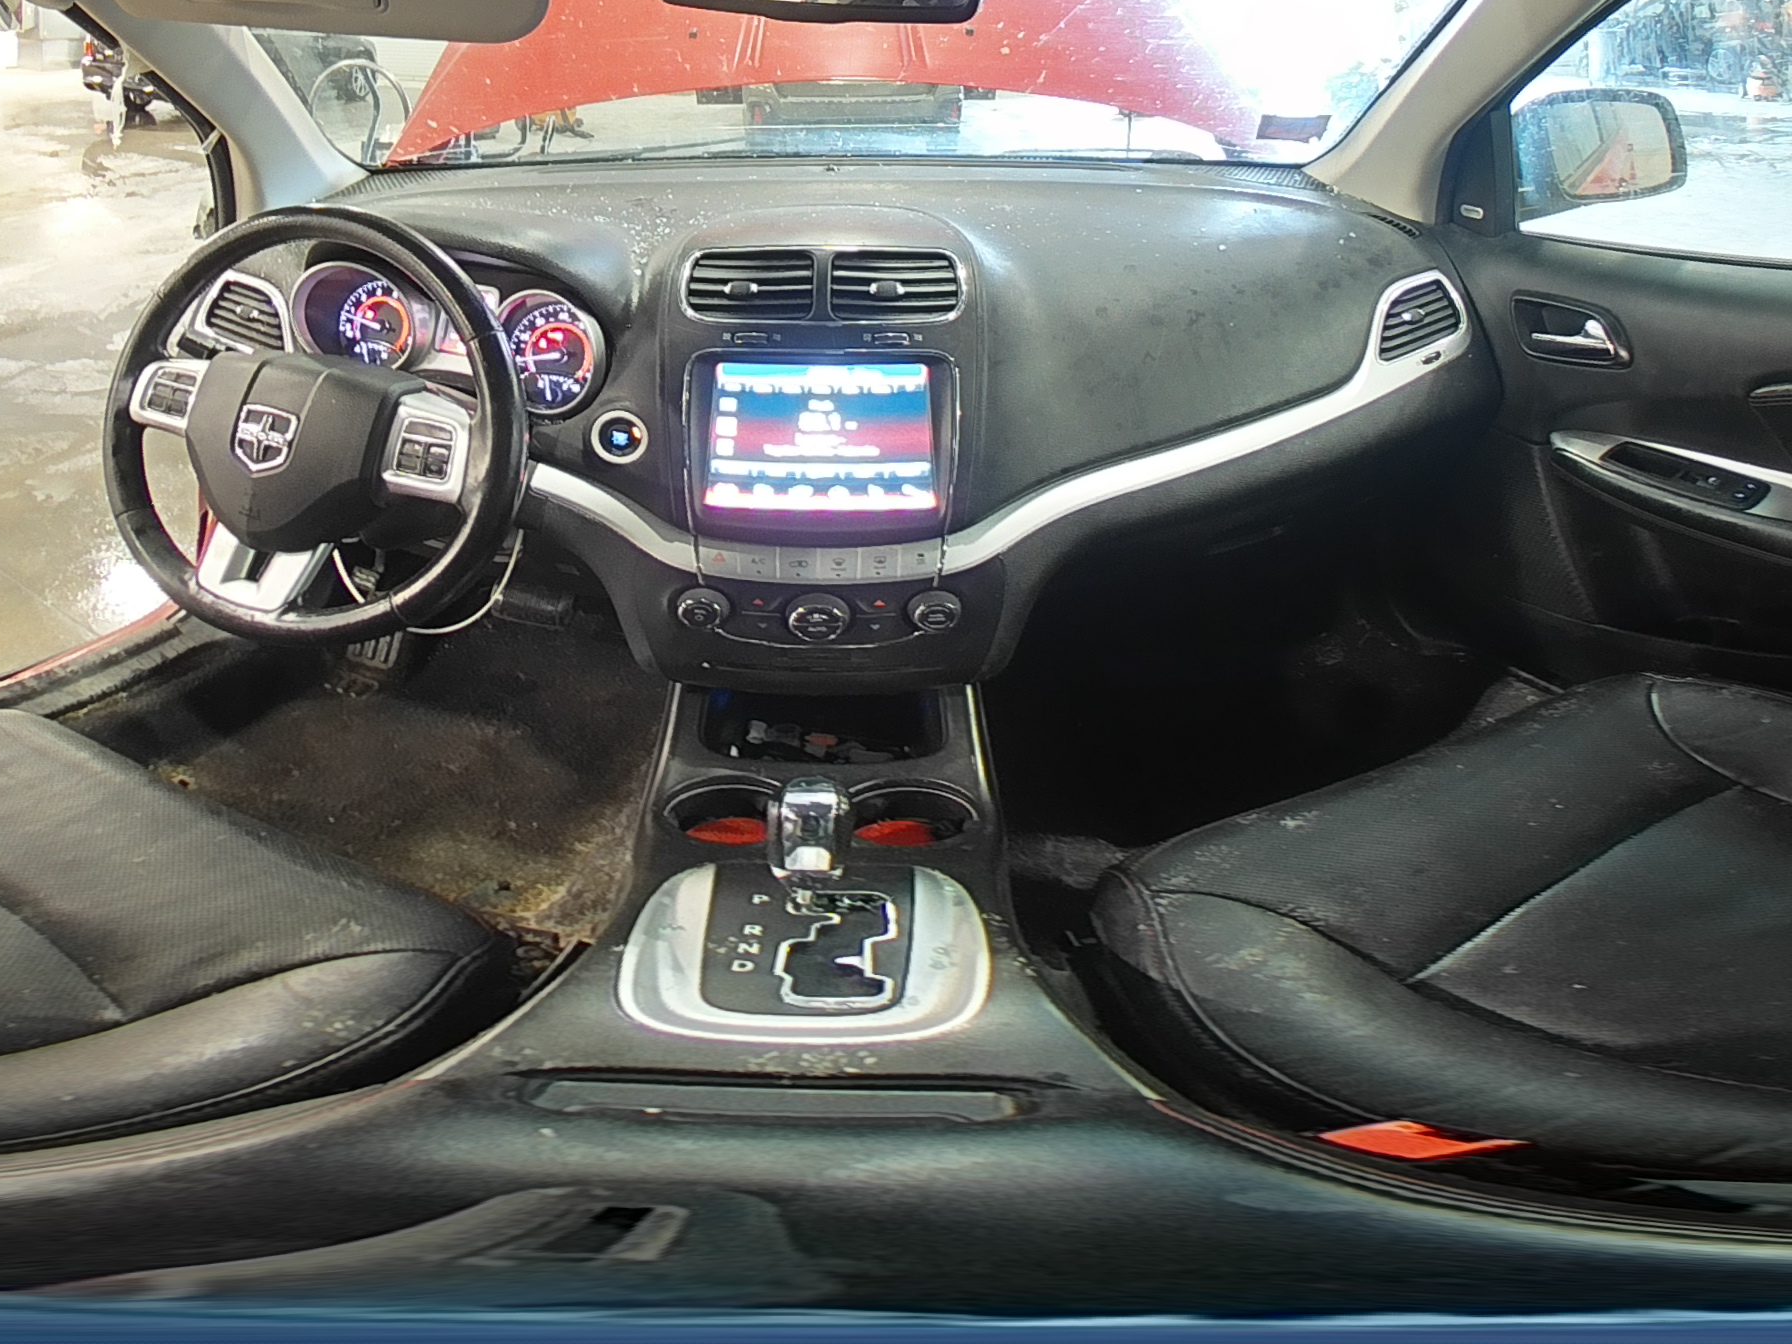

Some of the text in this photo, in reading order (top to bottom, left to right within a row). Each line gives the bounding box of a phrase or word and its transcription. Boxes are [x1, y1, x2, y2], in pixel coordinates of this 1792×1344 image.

[751, 893, 771, 905] P
[743, 924, 764, 937] R
[737, 942, 761, 955] N
[731, 959, 755, 972] D
